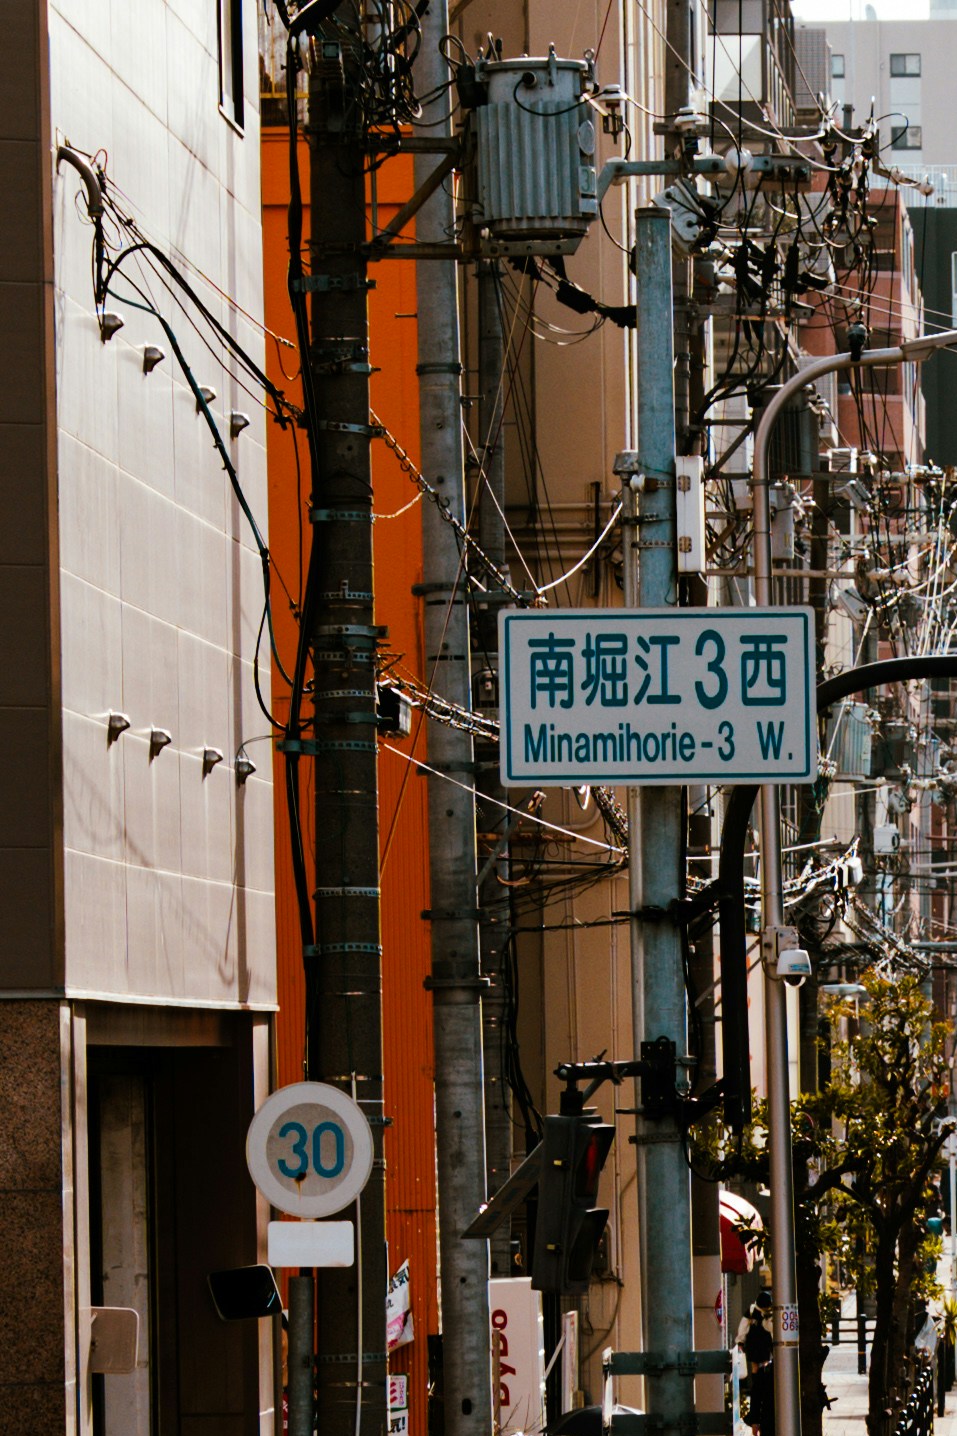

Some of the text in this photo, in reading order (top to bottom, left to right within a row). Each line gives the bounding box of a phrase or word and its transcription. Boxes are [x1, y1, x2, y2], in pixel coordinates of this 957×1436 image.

[528, 629, 788, 710] 南堀江3西
[524, 721, 793, 763] Minamihorie-3 W.
[278, 1121, 344, 1178] 30
